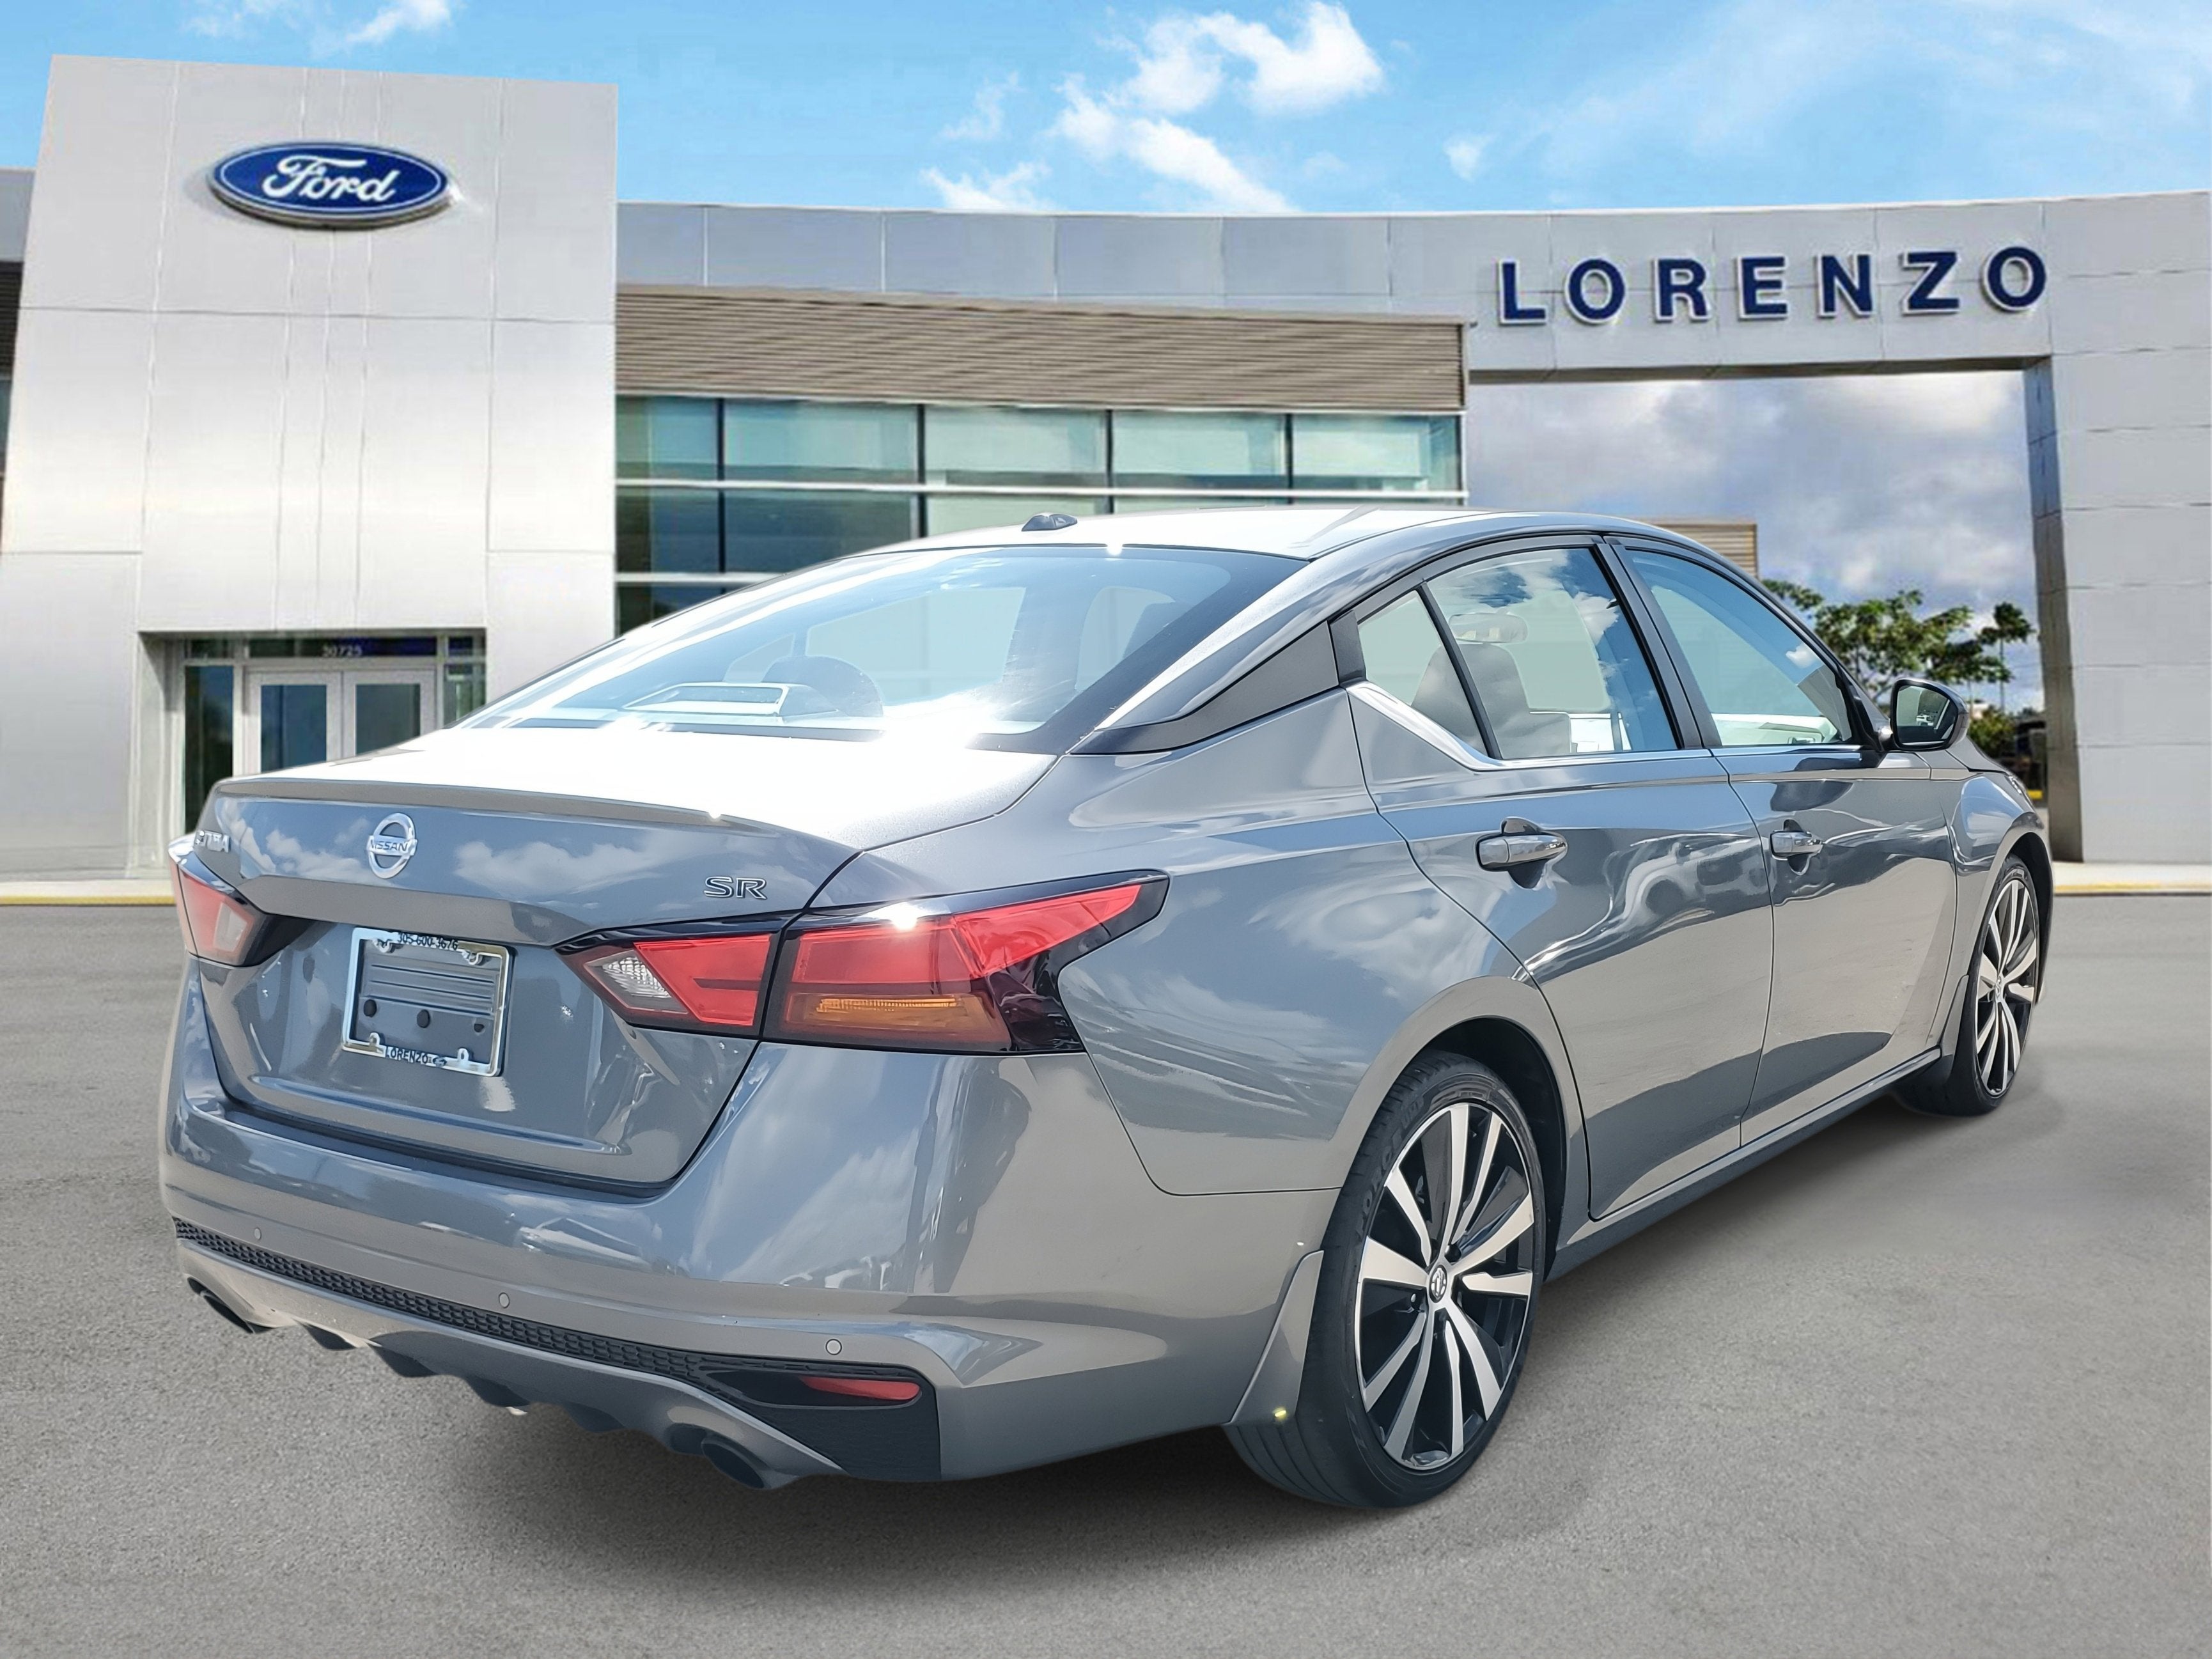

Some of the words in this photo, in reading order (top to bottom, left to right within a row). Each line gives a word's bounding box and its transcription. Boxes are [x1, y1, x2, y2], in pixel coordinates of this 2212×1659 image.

[262, 155, 400, 201] Ford
[1499, 246, 2047, 324] LORENZO
[370, 839, 409, 852] NISSAN
[703, 875, 767, 900] SR
[385, 1046, 429, 1064] LORENZO
